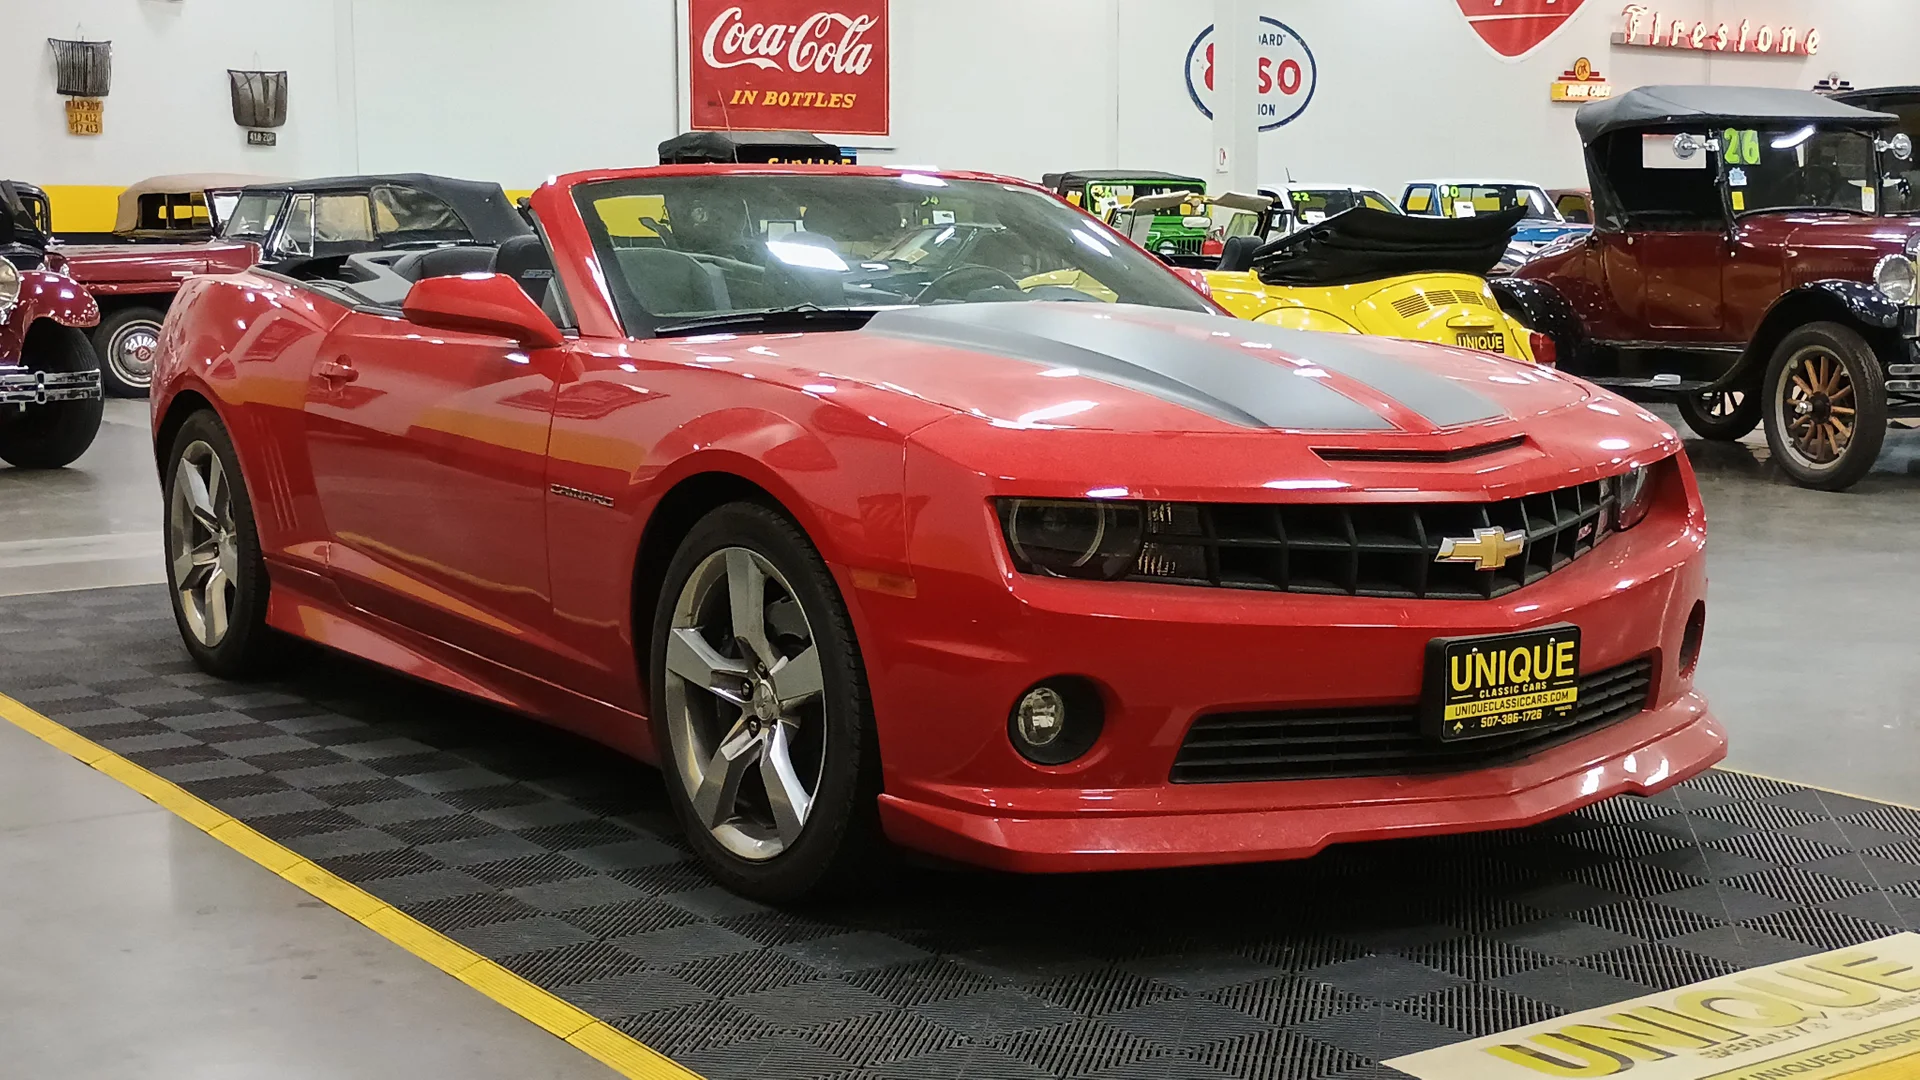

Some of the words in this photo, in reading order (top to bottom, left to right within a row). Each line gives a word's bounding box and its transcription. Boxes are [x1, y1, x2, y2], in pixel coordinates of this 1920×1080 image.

[702, 7, 880, 76] Coca-Cola
[1622, 3, 1821, 55] Firestone
[730, 90, 759, 105] IN
[762, 91, 857, 109] BOTTLES
[1723, 127, 1760, 165] 26
[1291, 191, 1311, 202] 22
[1458, 335, 1504, 350] UNIQUE
[1451, 640, 1575, 692] UNIQUE
[1455, 690, 1570, 717] UNIQUECLASSICCARS.COM
[1479, 684, 1520, 699] CLASSIC
[1522, 681, 1548, 692] CARS
[1480, 709, 1543, 728] 507-386-1726
[1486, 951, 1920, 1079] UNIQUE
